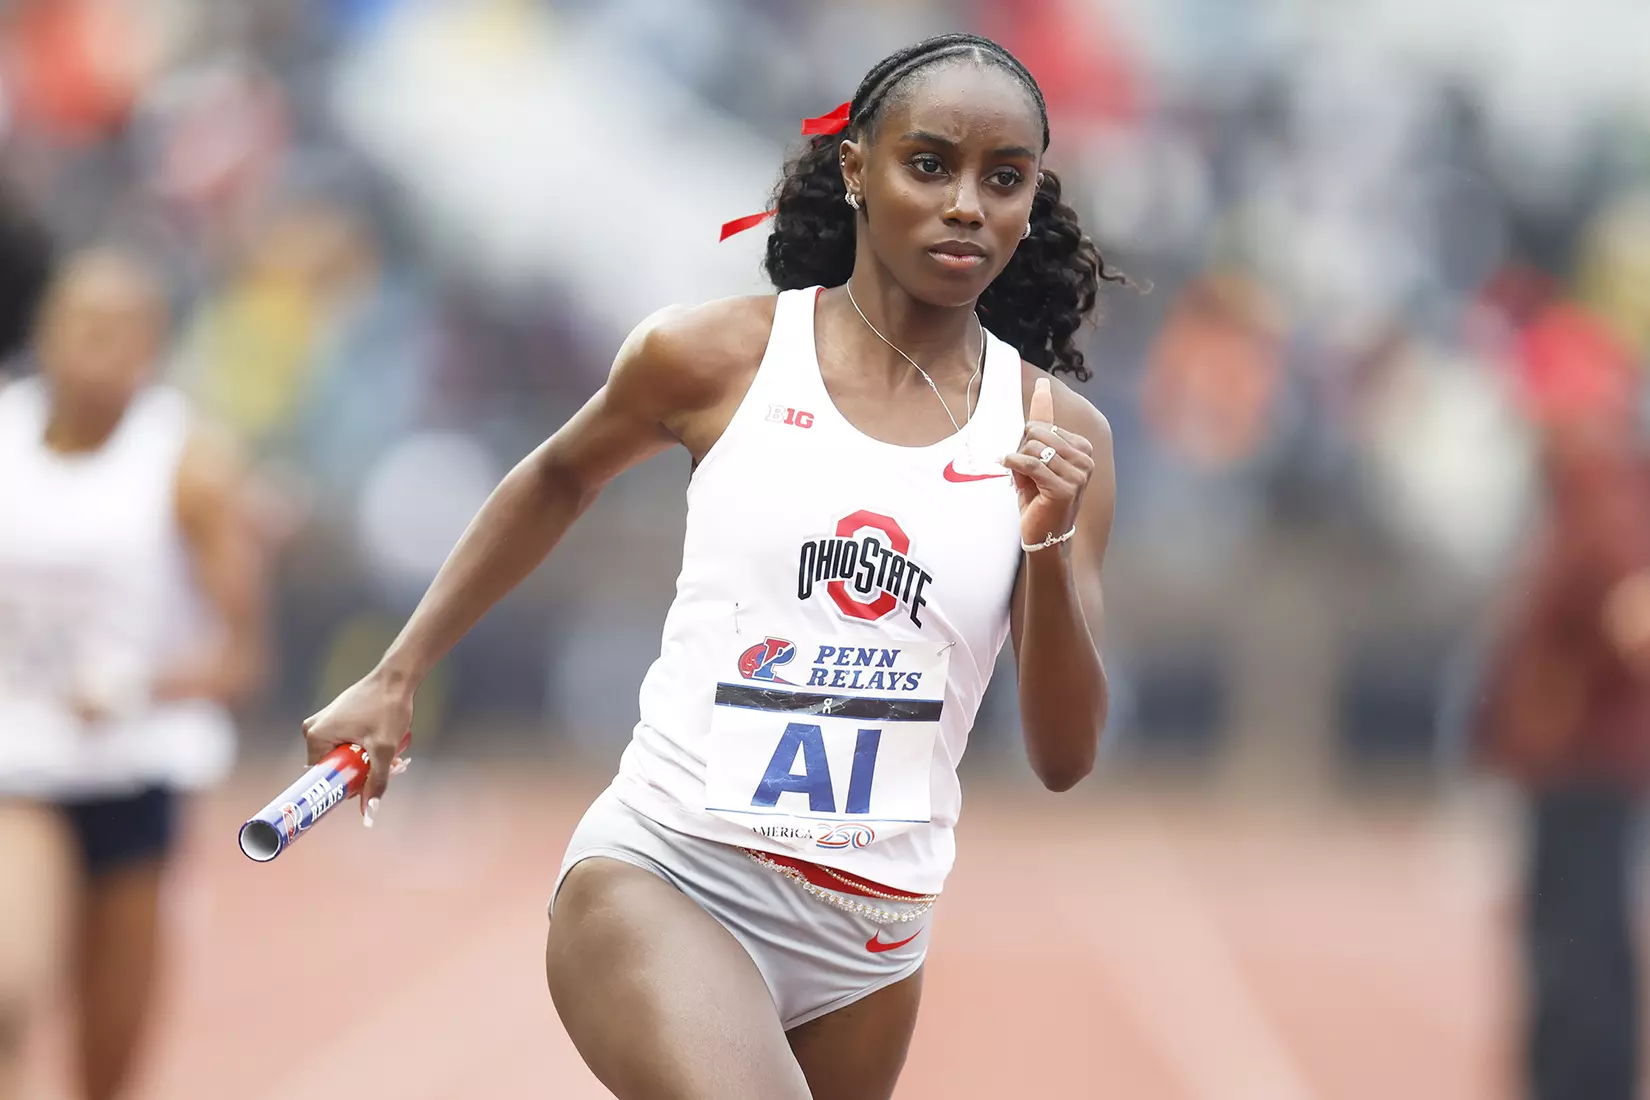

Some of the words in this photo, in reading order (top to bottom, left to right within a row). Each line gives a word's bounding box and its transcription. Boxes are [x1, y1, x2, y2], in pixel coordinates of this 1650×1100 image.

[814, 645, 901, 668] PENN
[806, 667, 922, 692] RELAYS
[750, 722, 882, 814] AI
[311, 783, 344, 822] RELAYS
[751, 826, 814, 840] AMERICA
